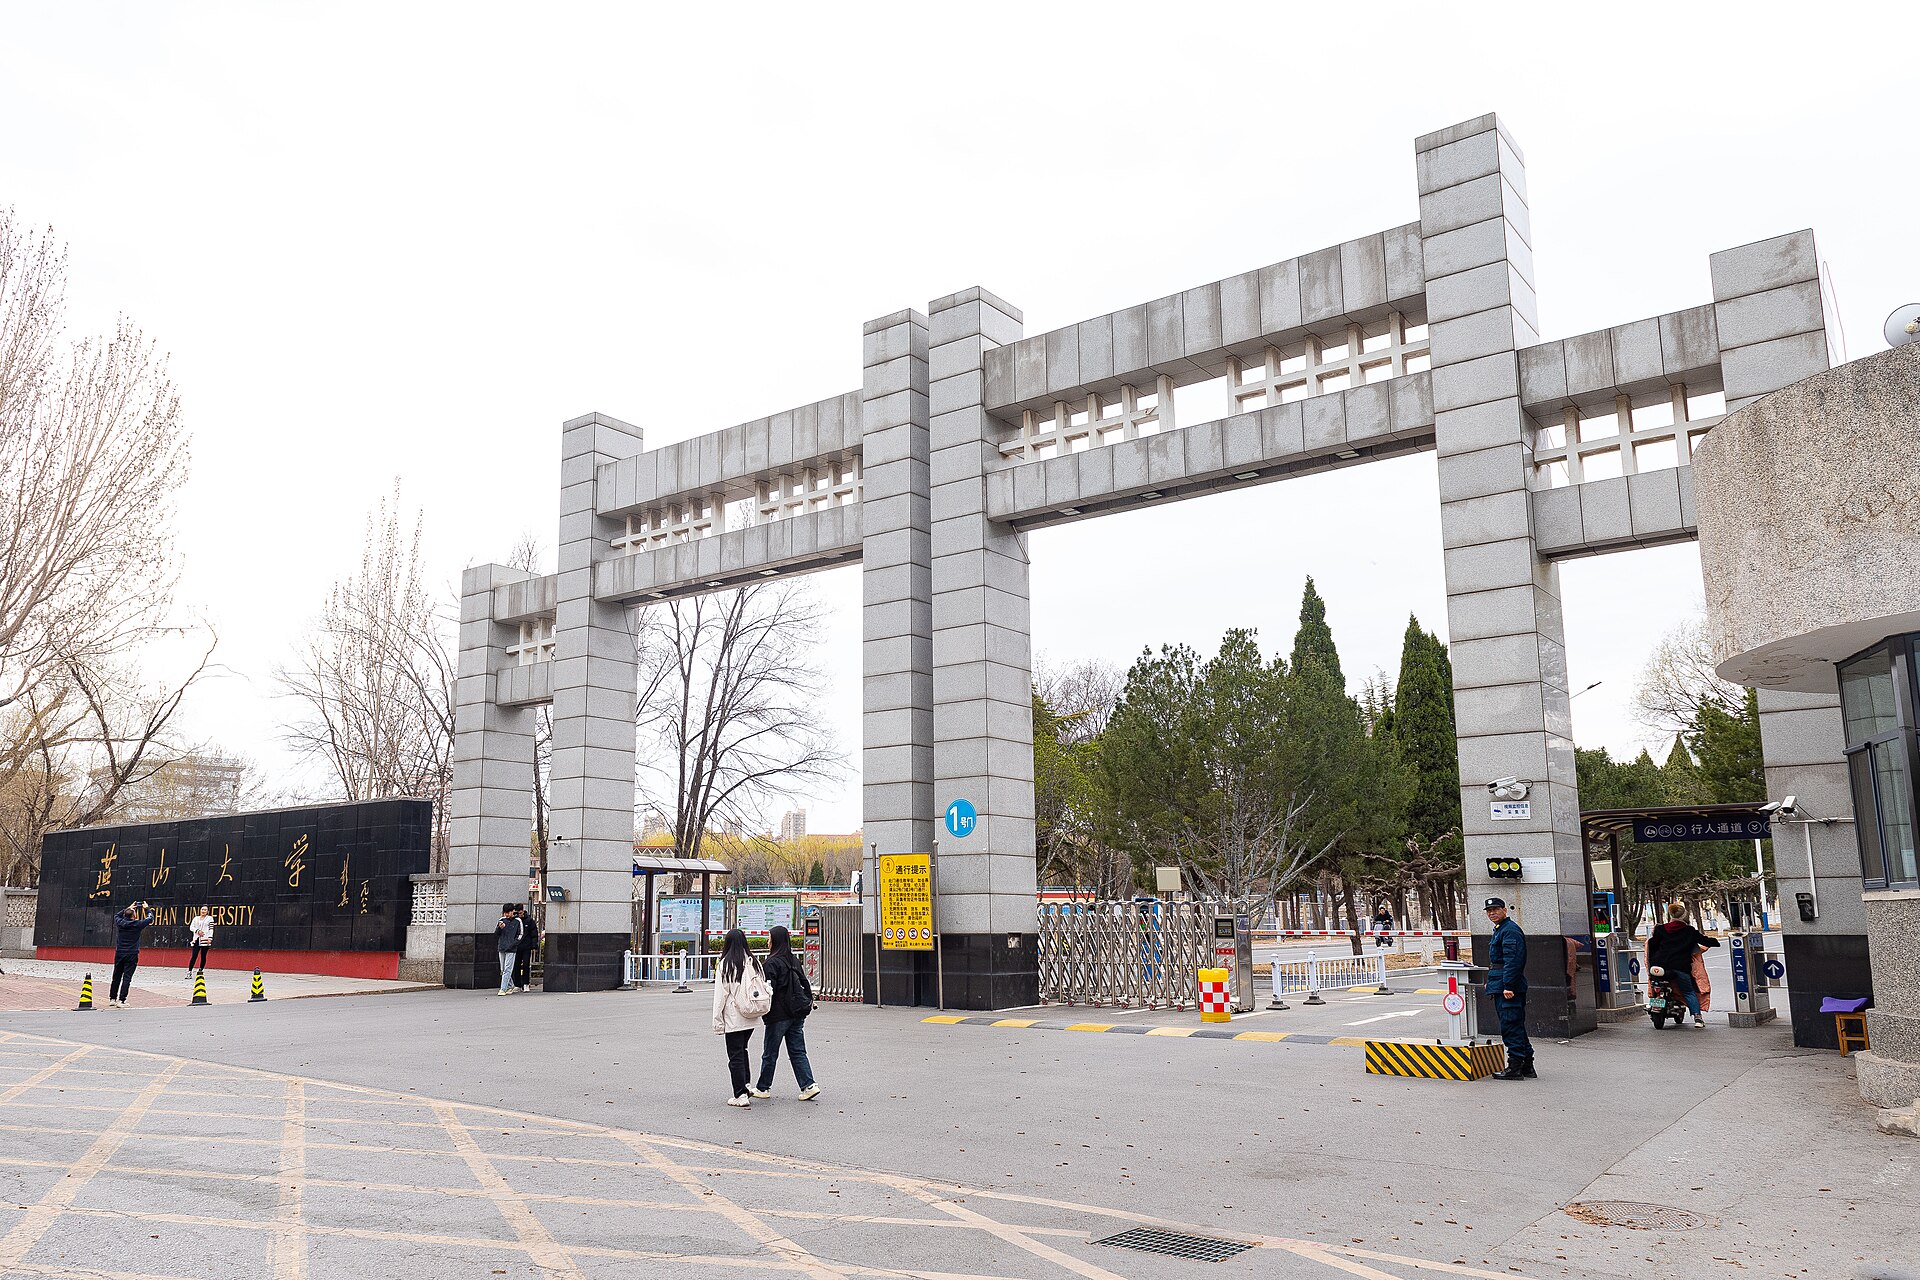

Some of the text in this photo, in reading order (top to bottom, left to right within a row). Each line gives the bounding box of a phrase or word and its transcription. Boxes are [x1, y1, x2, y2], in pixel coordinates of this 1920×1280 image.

[1691, 822, 1743, 835] 行人通道
[89, 833, 311, 899] 燕山大学
[895, 865, 927, 875] 通行提示
[134, 905, 255, 926] NSHAN UNERSITY
